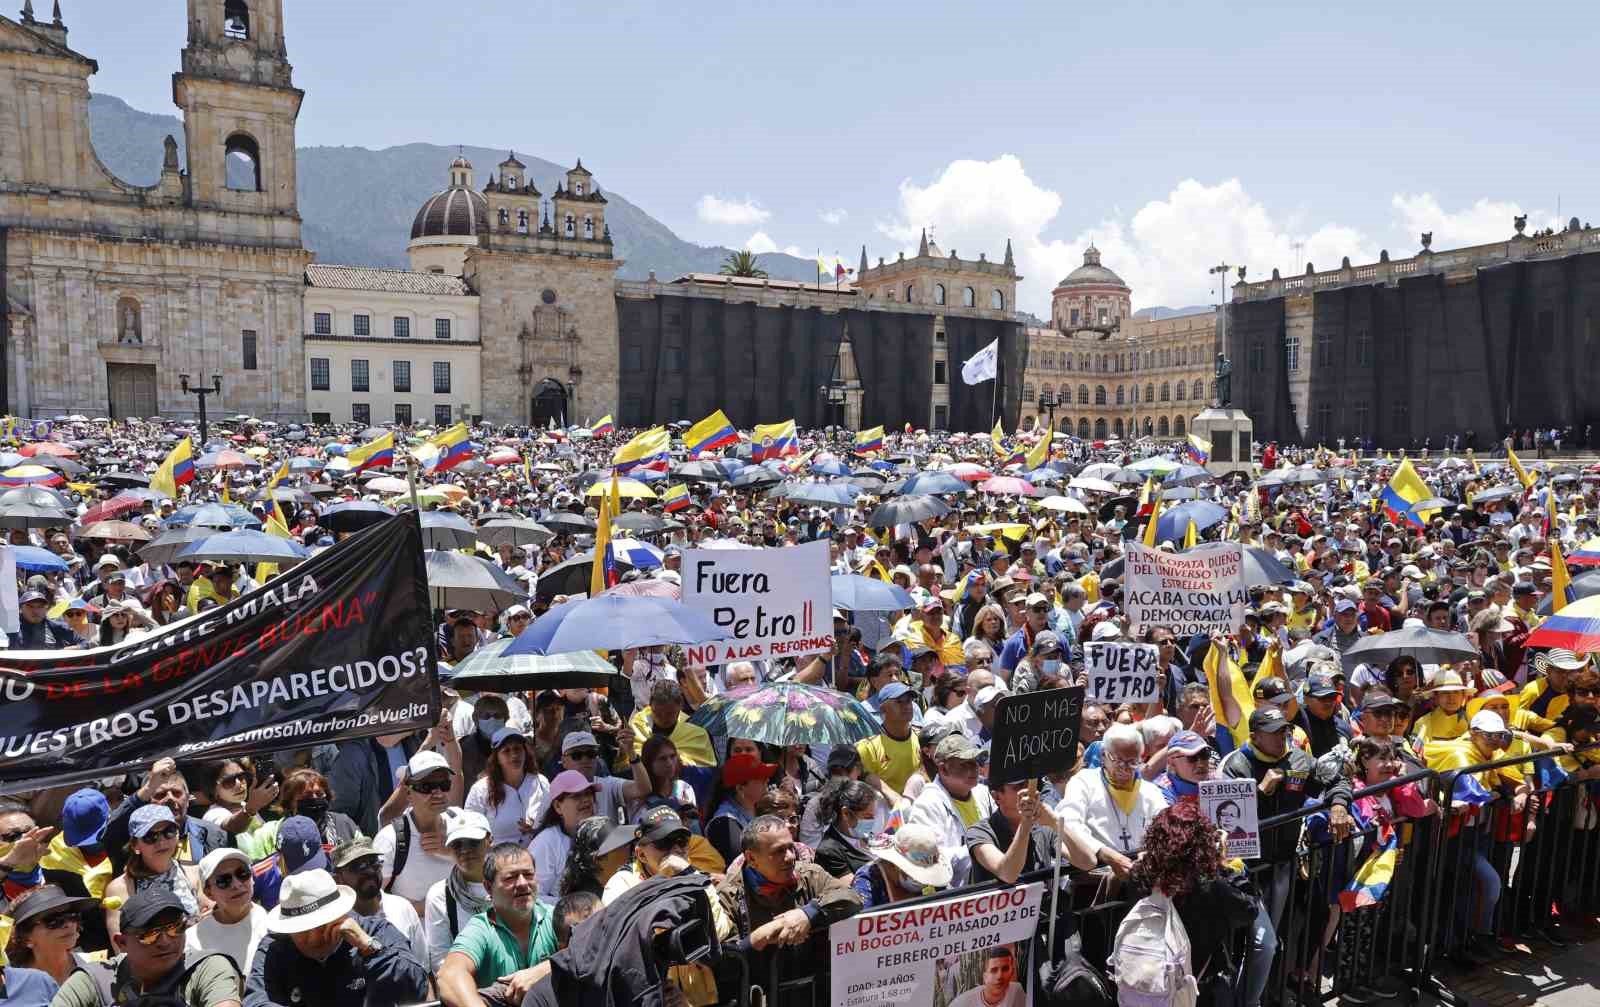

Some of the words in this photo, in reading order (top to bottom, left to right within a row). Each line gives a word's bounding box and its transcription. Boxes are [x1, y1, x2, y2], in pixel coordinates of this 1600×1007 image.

[1128, 552, 1140, 562] EL
[1143, 552, 1204, 568] PSICOPATA
[1208, 551, 1241, 568] DUEÑO
[1134, 564, 1152, 575] DEL
[1155, 566, 1211, 579] UNIVERSO
[1214, 570, 1219, 579] Y
[1222, 566, 1237, 577] LAS
[696, 561, 770, 594] Fuera
[1162, 578, 1214, 590] ESTRELLAS
[226, 575, 318, 625] MALA
[1128, 591, 1184, 606] ACABA
[1190, 592, 1222, 606] CON
[1139, 624, 1150, 635] E
[1168, 623, 1232, 635] OLOMIA
[1141, 608, 1233, 622] DEMOCRACIA
[688, 645, 716, 665] NO
[726, 646, 737, 659] A
[739, 645, 763, 658] LAS
[770, 635, 834, 655] REFORMAS
[1091, 644, 1158, 673] FUERA
[0, 709, 159, 757] UESTROS
[167, 646, 428, 725] DESAPARECIDOS?
[1094, 676, 1155, 699] PETRO
[1005, 704, 1031, 725] NO
[1044, 697, 1079, 720] MAS
[1003, 728, 1073, 769] ABORTO
[1201, 785, 1214, 796] SE
[1217, 783, 1253, 795] BUSCA
[858, 889, 1026, 936] DESAPARECIDO
[836, 942, 855, 956] EN
[860, 932, 924, 951] BOGOTA,
[929, 927, 944, 939] EL
[948, 916, 999, 934] PASADO
[1003, 910, 1016, 923] 12
[1021, 906, 1036, 919] DE
[877, 947, 939, 969] FEBRERO
[944, 942, 966, 955] DEL
[971, 933, 1001, 949] 2024
[847, 982, 874, 994] EDAD:
[889, 974, 916, 986] AÑOS
